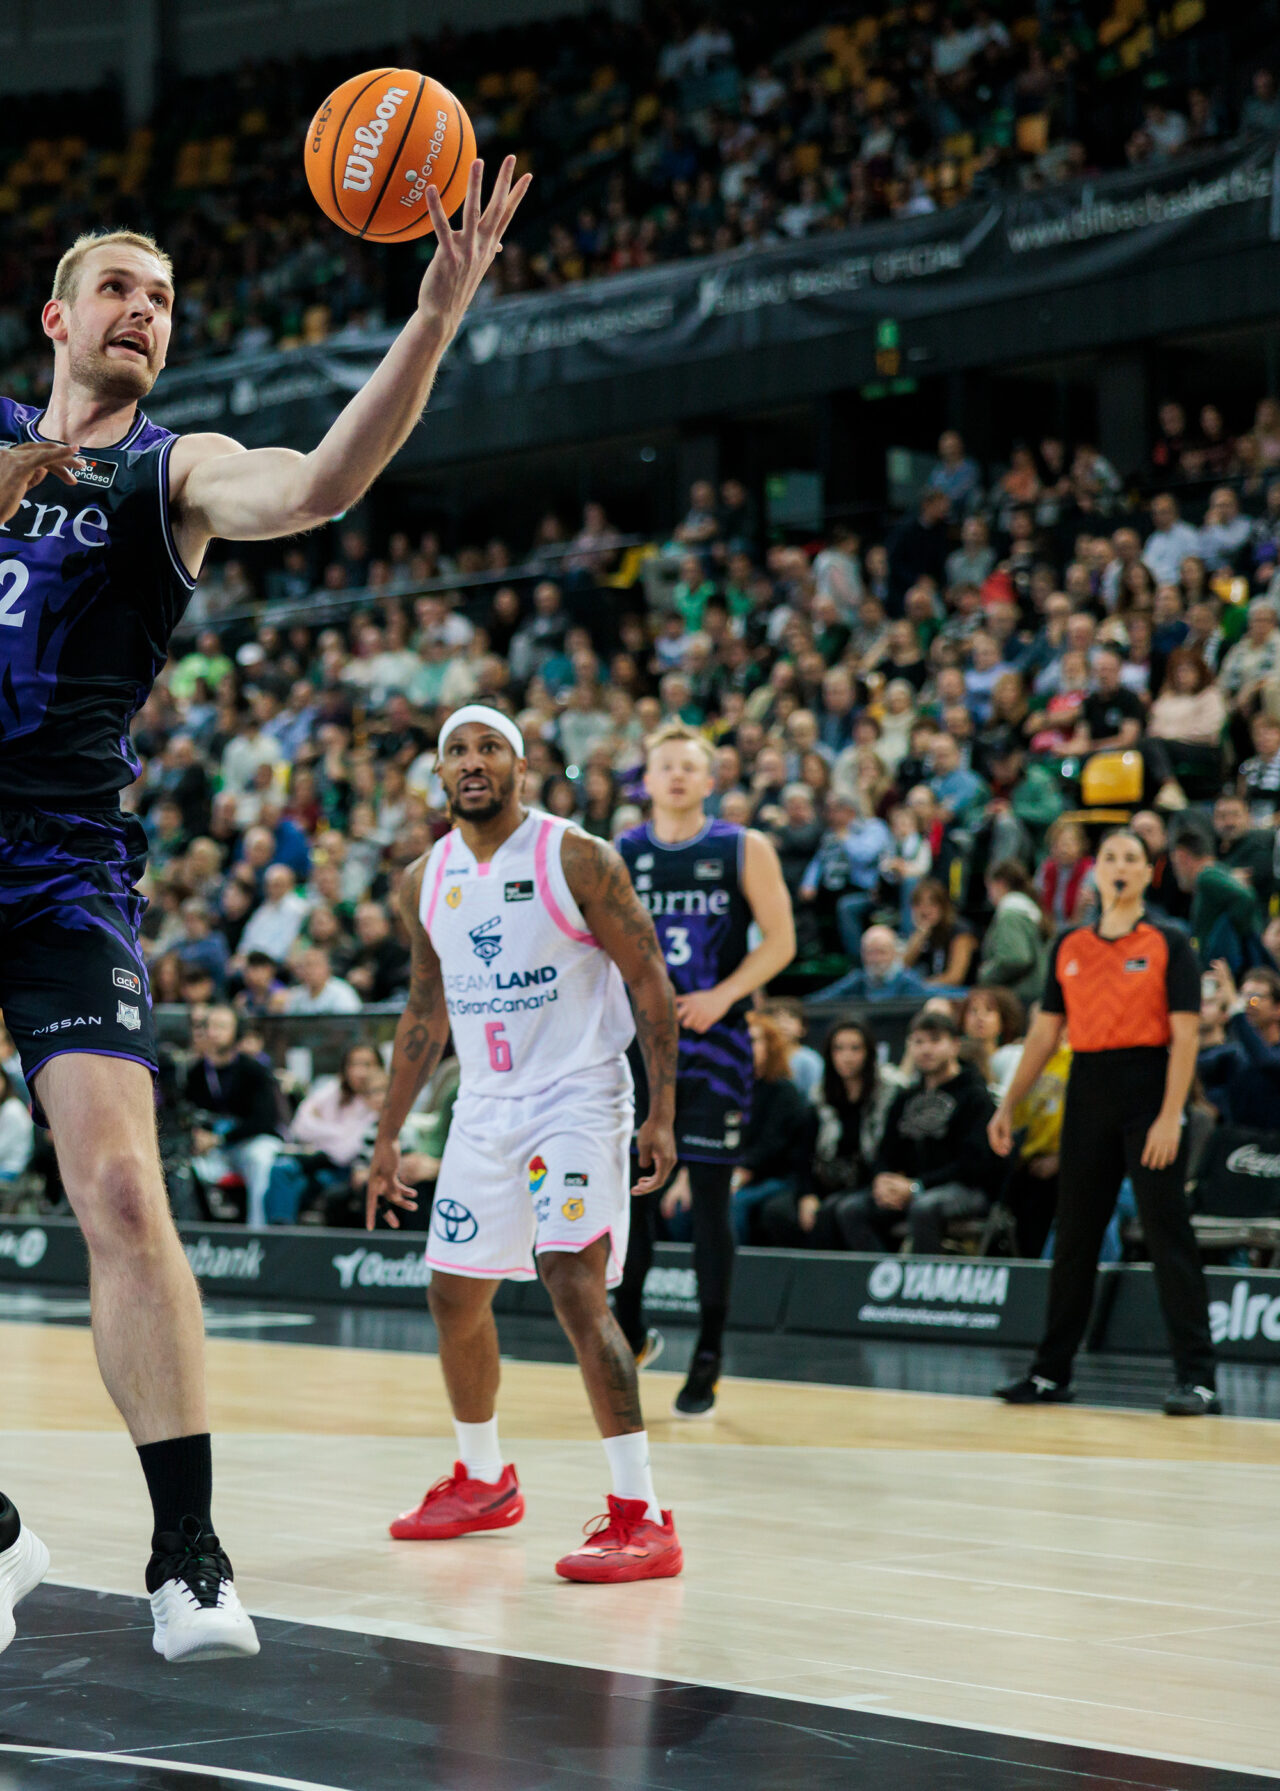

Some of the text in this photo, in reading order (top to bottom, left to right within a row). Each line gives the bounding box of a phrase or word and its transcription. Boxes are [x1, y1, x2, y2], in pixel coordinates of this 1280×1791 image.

[343, 86, 409, 192] Wilson
[422, 110, 448, 177] endesa
[639, 888, 730, 915] urne
[665, 926, 692, 966] 3
[116, 977, 136, 989] acb
[32, 1016, 102, 1036] NISSAN
[484, 1021, 513, 1072] 6
[901, 1263, 1010, 1306] YAMAHA
